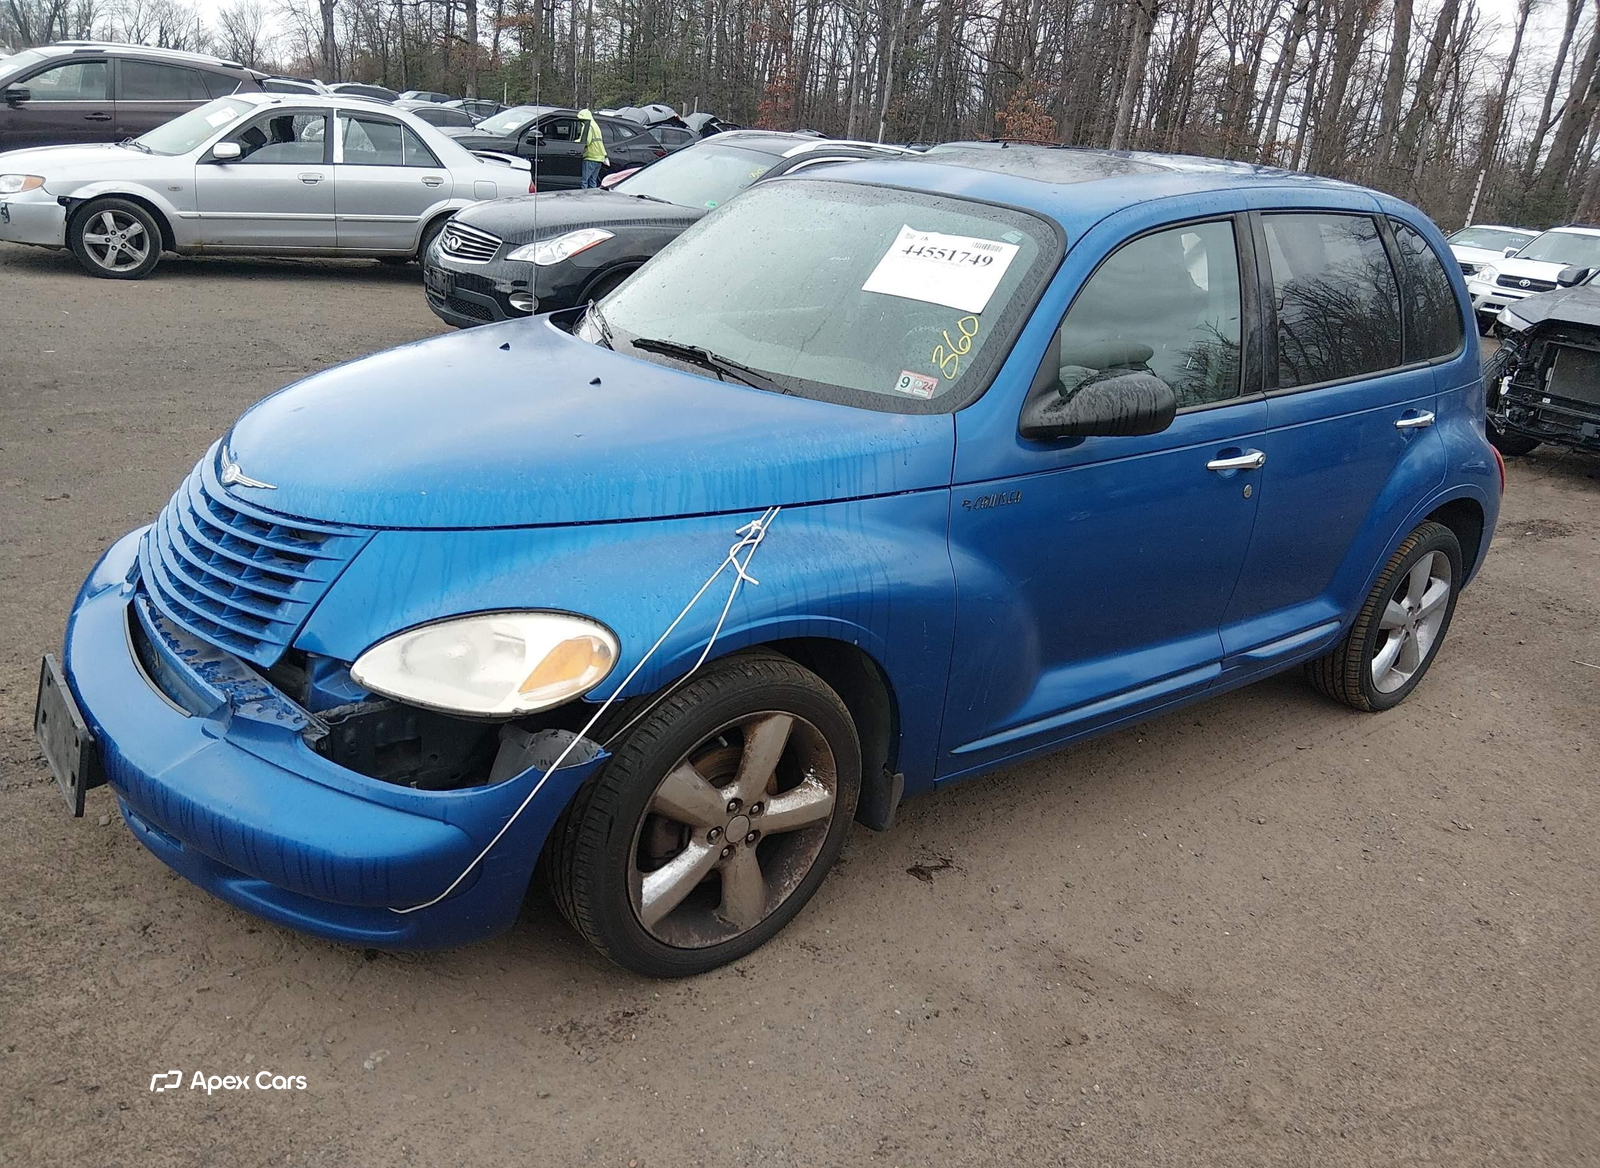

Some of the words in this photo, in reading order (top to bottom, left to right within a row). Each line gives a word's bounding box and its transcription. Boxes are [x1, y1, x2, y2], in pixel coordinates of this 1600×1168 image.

[902, 244, 994, 267] 44551749
[931, 315, 980, 380] 360
[900, 376, 911, 388] 9
[922, 381, 934, 391] 24
